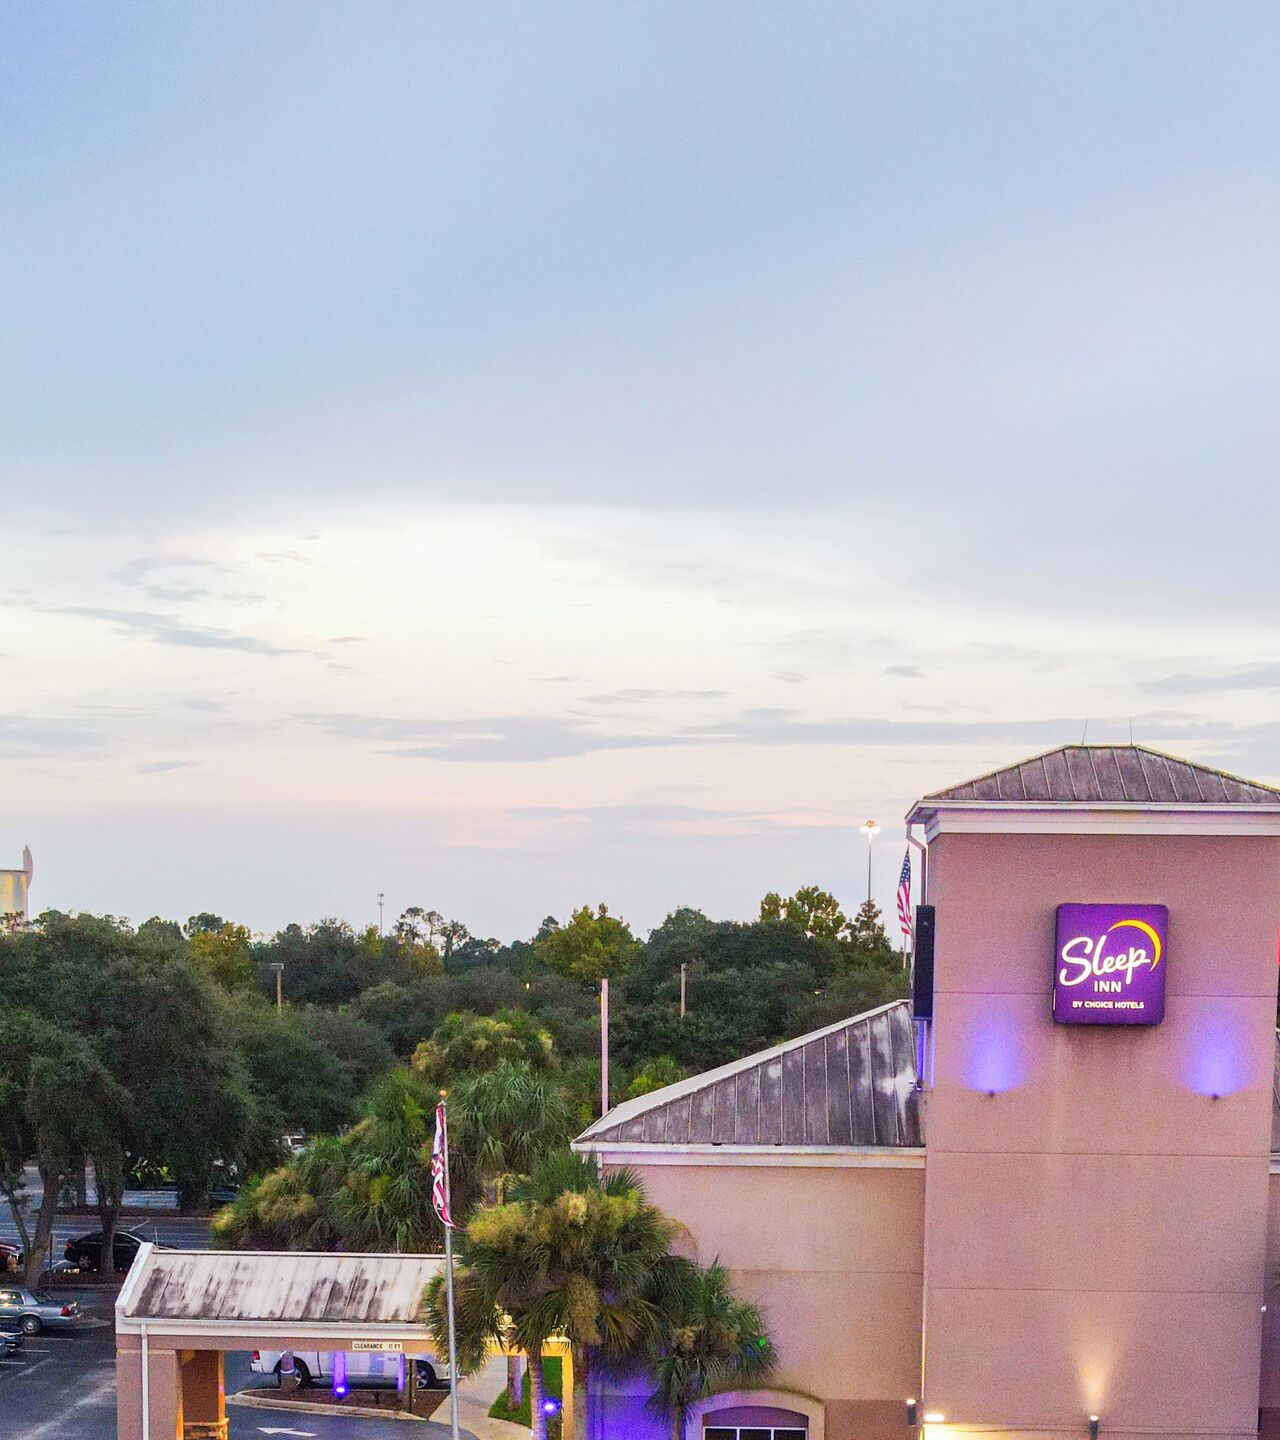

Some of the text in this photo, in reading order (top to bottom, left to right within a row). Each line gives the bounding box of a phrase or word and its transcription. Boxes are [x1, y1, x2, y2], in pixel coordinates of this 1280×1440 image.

[1059, 935, 1151, 986] Sleep
[1094, 981, 1122, 992] INN
[1084, 1001, 1114, 1009] CHOICE
[1114, 1001, 1145, 1009] HOTELS
